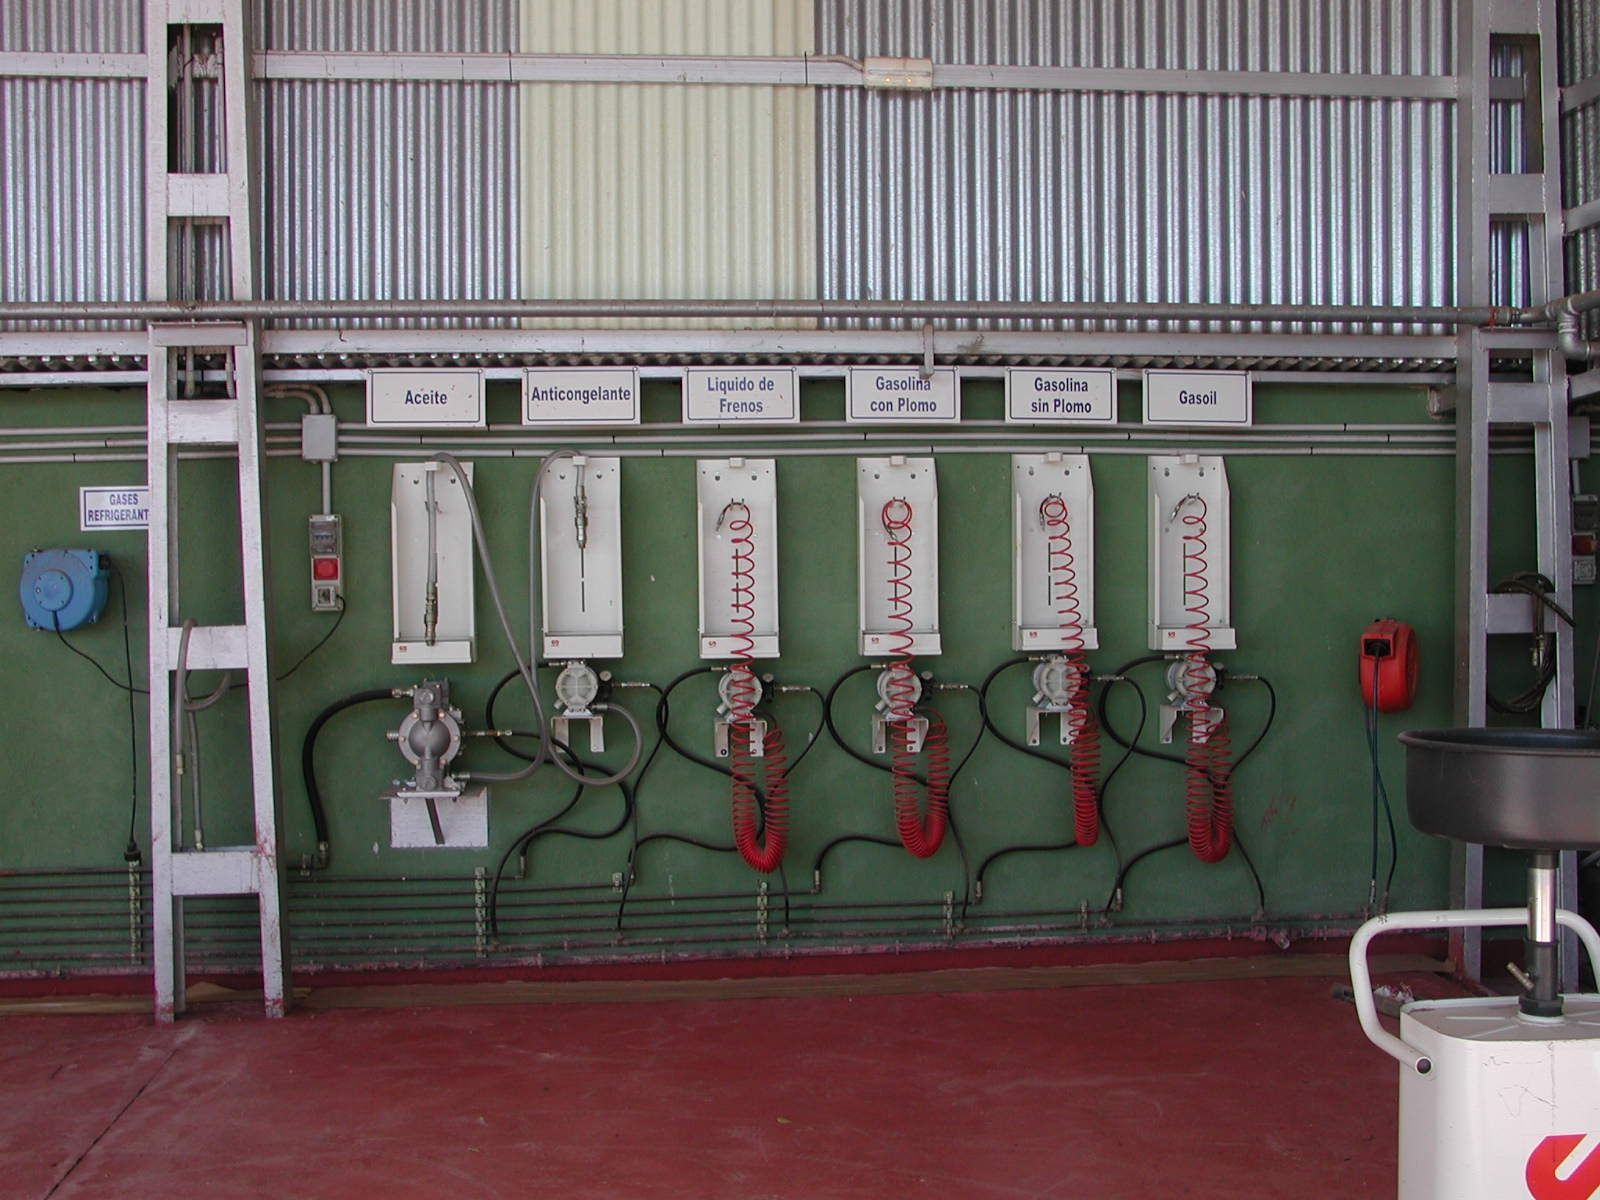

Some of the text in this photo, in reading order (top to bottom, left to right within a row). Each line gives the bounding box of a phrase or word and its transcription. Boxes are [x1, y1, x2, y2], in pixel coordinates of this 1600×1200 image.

[707, 376, 775, 396] Liquido de
[875, 375, 932, 392] Gasolina
[1034, 376, 1089, 393] Gasolina
[404, 388, 448, 406] Aceite
[531, 384, 632, 405] Anticongelante
[1178, 389, 1218, 406] Gasoil
[719, 397, 764, 413] Frenos
[869, 397, 937, 413] con Plomo
[1031, 398, 1092, 414] sin Plomo
[109, 493, 139, 506] GASES
[87, 508, 150, 522] REFRIGERANT
